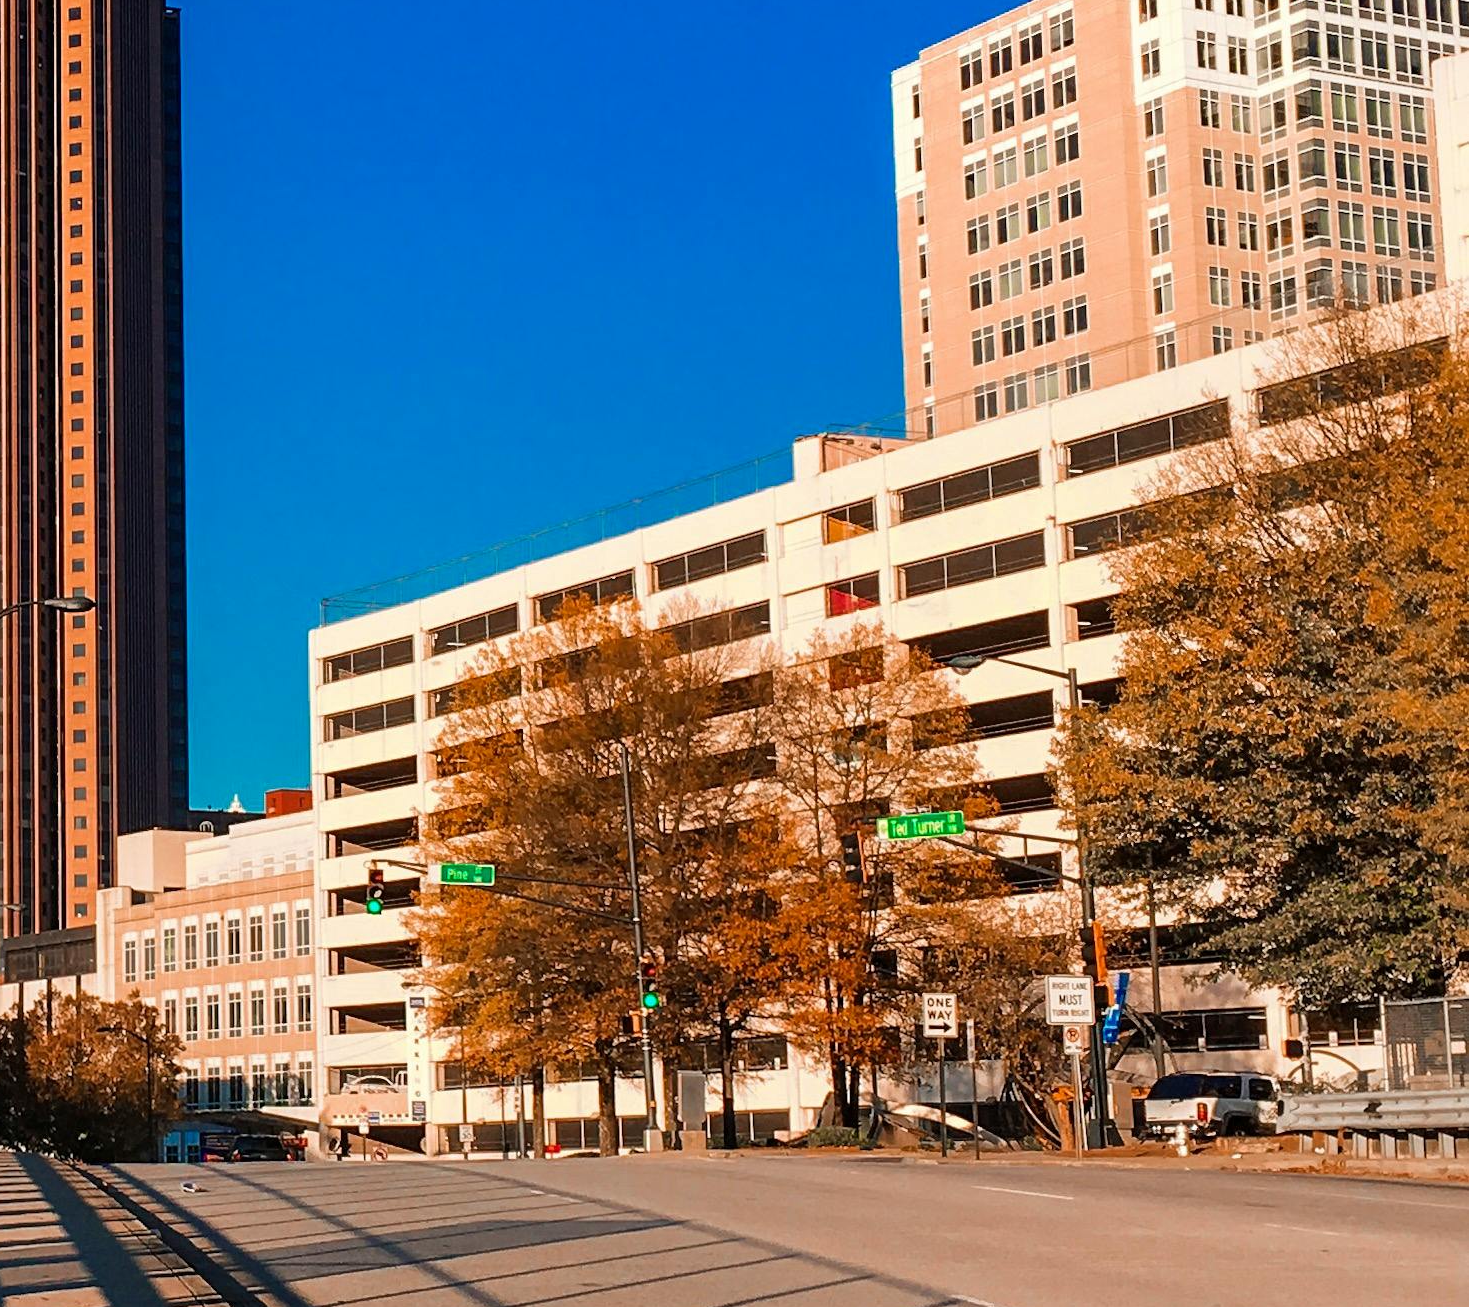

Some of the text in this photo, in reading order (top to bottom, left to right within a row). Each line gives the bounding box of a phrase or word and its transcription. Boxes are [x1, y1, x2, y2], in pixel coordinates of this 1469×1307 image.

[891, 820, 908, 837] Ted
[912, 818, 945, 835] Turner
[447, 868, 468, 880] Pine
[1052, 982, 1088, 990] RIGHT LANE
[927, 997, 953, 1007] ONE
[1059, 994, 1082, 1005] MUST
[927, 1010, 953, 1020] WAY
